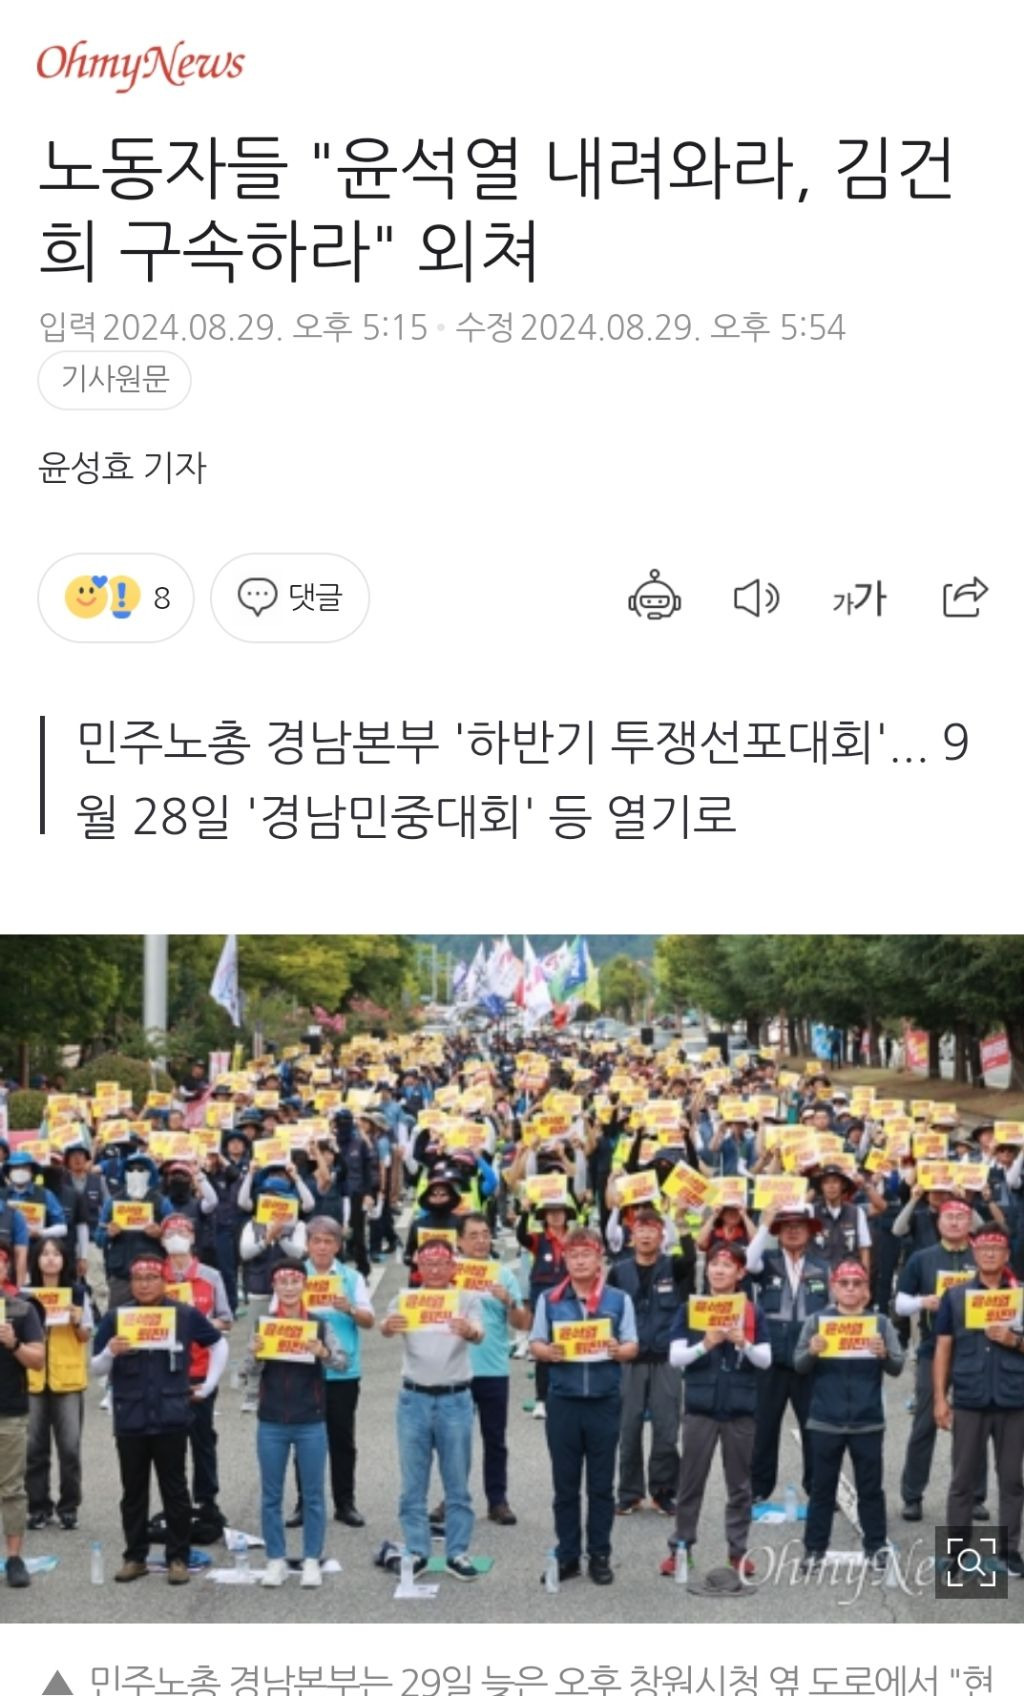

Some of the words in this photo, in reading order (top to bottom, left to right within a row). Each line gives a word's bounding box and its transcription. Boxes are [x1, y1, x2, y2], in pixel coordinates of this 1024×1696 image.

[37, 40, 246, 94] OhmyNews
[38, 135, 289, 204] 노동자들
[313, 135, 518, 204] "윤석열
[548, 135, 809, 204] 내려와라,
[836, 135, 952, 204] 김건
[39, 218, 94, 285] 희
[119, 218, 393, 285] 구속하라"
[418, 218, 535, 285] 외쳐
[39, 311, 95, 344] 입력
[103, 311, 283, 344] 2024.08.29.
[292, 311, 353, 344] 오후
[363, 311, 428, 344] 5:15
[455, 311, 513, 344] 수정
[520, 311, 700, 344] 2024.08.29.
[710, 311, 771, 344] 오후
[781, 311, 847, 344] 5:54
[62, 363, 171, 394] 기사원문
[37, 450, 135, 486] 윤성효
[144, 450, 208, 486] 기자
[153, 586, 171, 610] 8
[289, 582, 344, 612] 댓글
[79, 719, 252, 766] 민주노총
[267, 719, 440, 766] 경남본부
[457, 719, 594, 766] '하반기
[610, 719, 927, 766] 투쟁선포대회'...
[943, 719, 969, 766] 9
[76, 794, 116, 841] 월
[133, 794, 229, 841] 28일
[249, 794, 533, 841] '경남민중대회'
[548, 794, 593, 841] 등
[608, 794, 737, 841] 열기로
